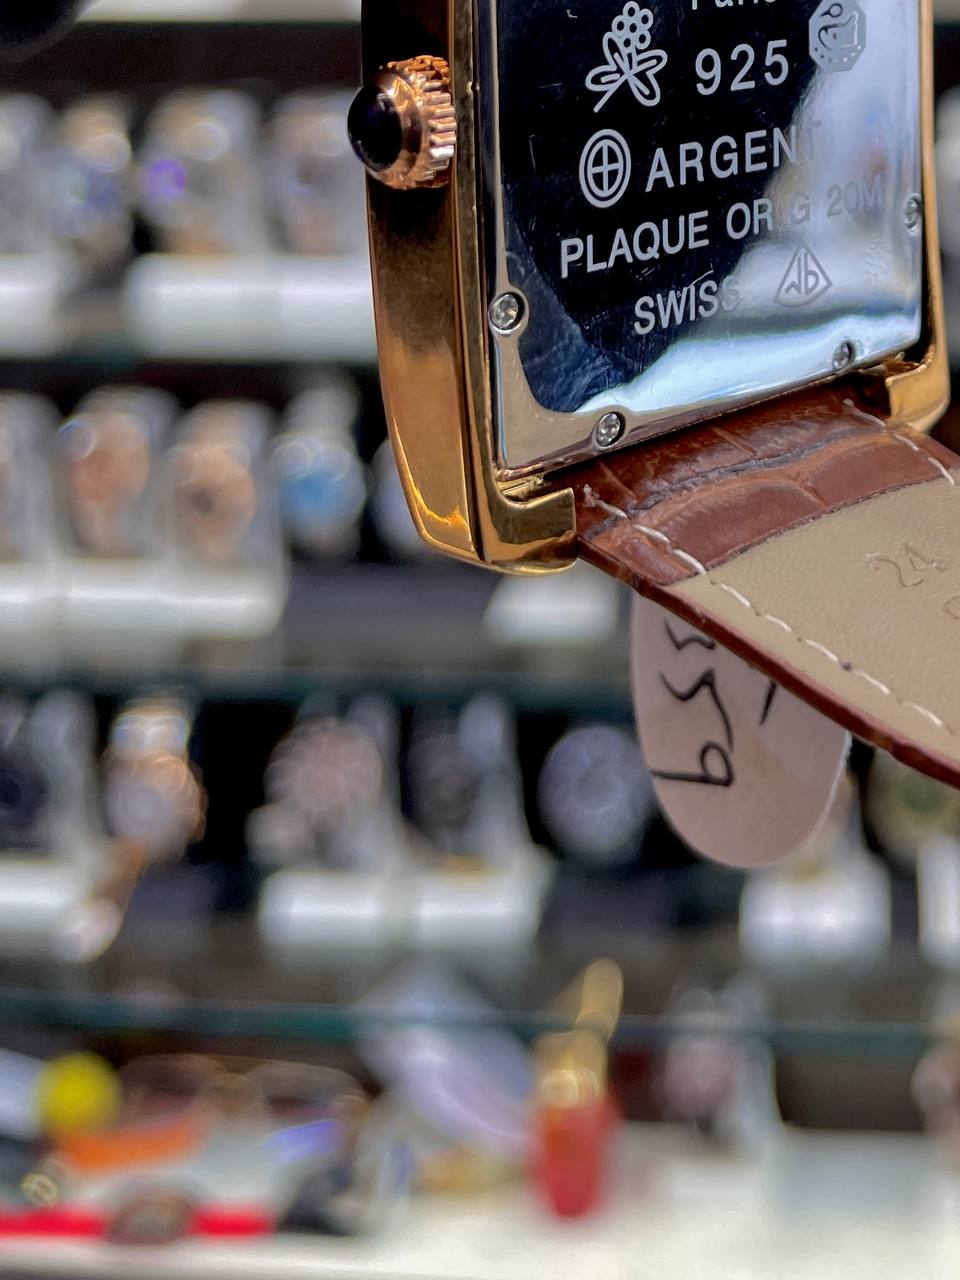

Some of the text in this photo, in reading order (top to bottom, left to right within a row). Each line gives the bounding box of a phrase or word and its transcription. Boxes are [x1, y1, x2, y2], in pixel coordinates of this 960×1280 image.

[694, 39, 789, 96] 925
[645, 120, 822, 193] ARGENT
[560, 210, 710, 279] PLAQUE
[726, 197, 774, 240] OR
[633, 275, 742, 336] SWISS
